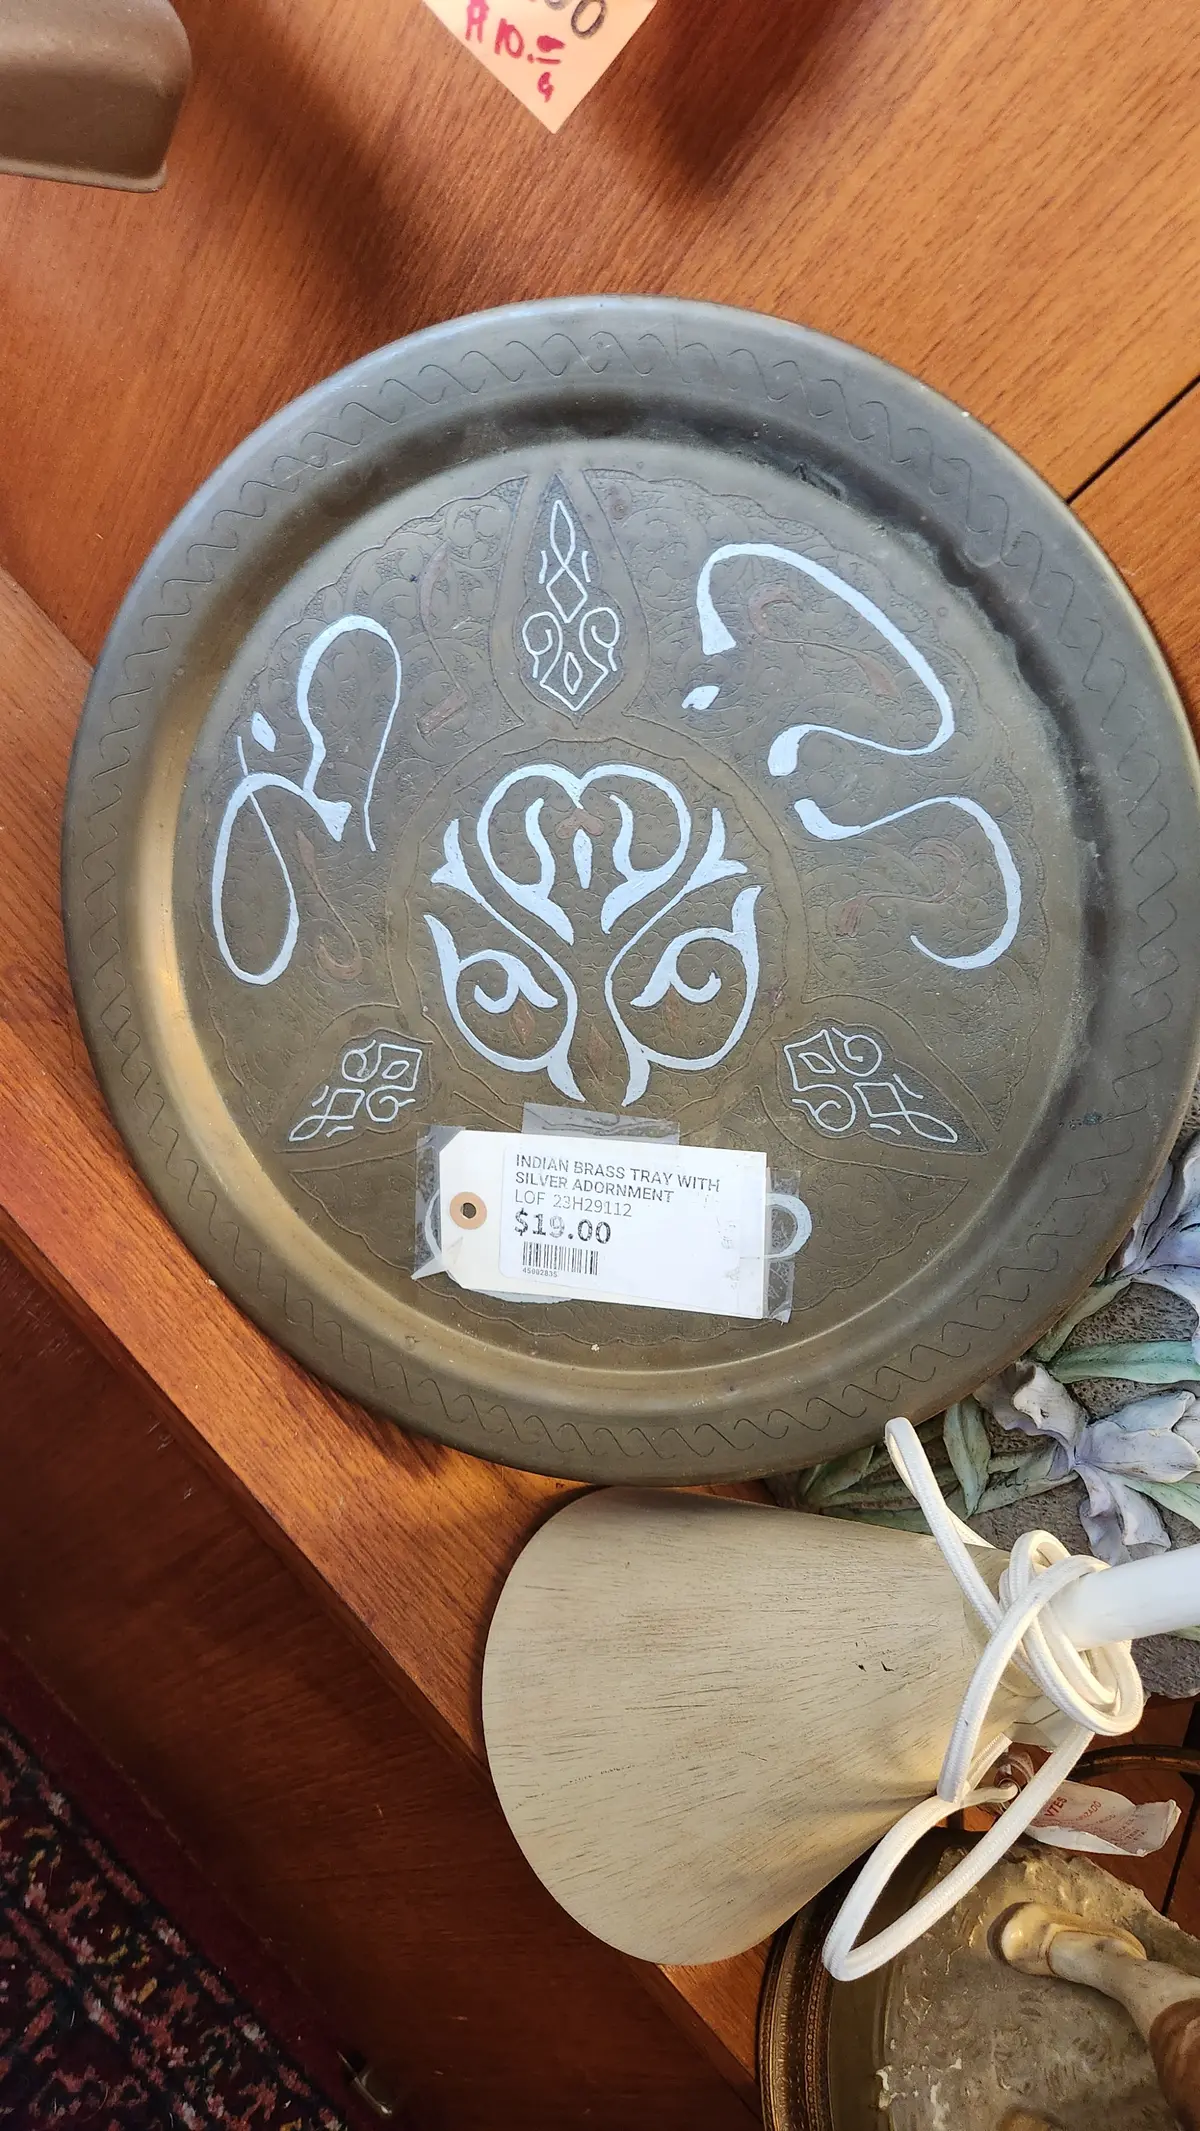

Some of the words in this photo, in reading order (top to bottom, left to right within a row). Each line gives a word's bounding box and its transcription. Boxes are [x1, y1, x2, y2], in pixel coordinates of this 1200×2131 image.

[515, 1171, 569, 1190] SILVER
[571, 1178, 674, 1203] ADORNMENT
[516, 1154, 569, 1173] INDIAN
[573, 1160, 625, 1179] BRASS
[630, 1167, 673, 1186] TRAY
[677, 1174, 720, 1192] WITH
[514, 1188, 546, 1206] LOF
[553, 1194, 633, 1218] 23H29112
[514, 1207, 612, 1245] $19.00
